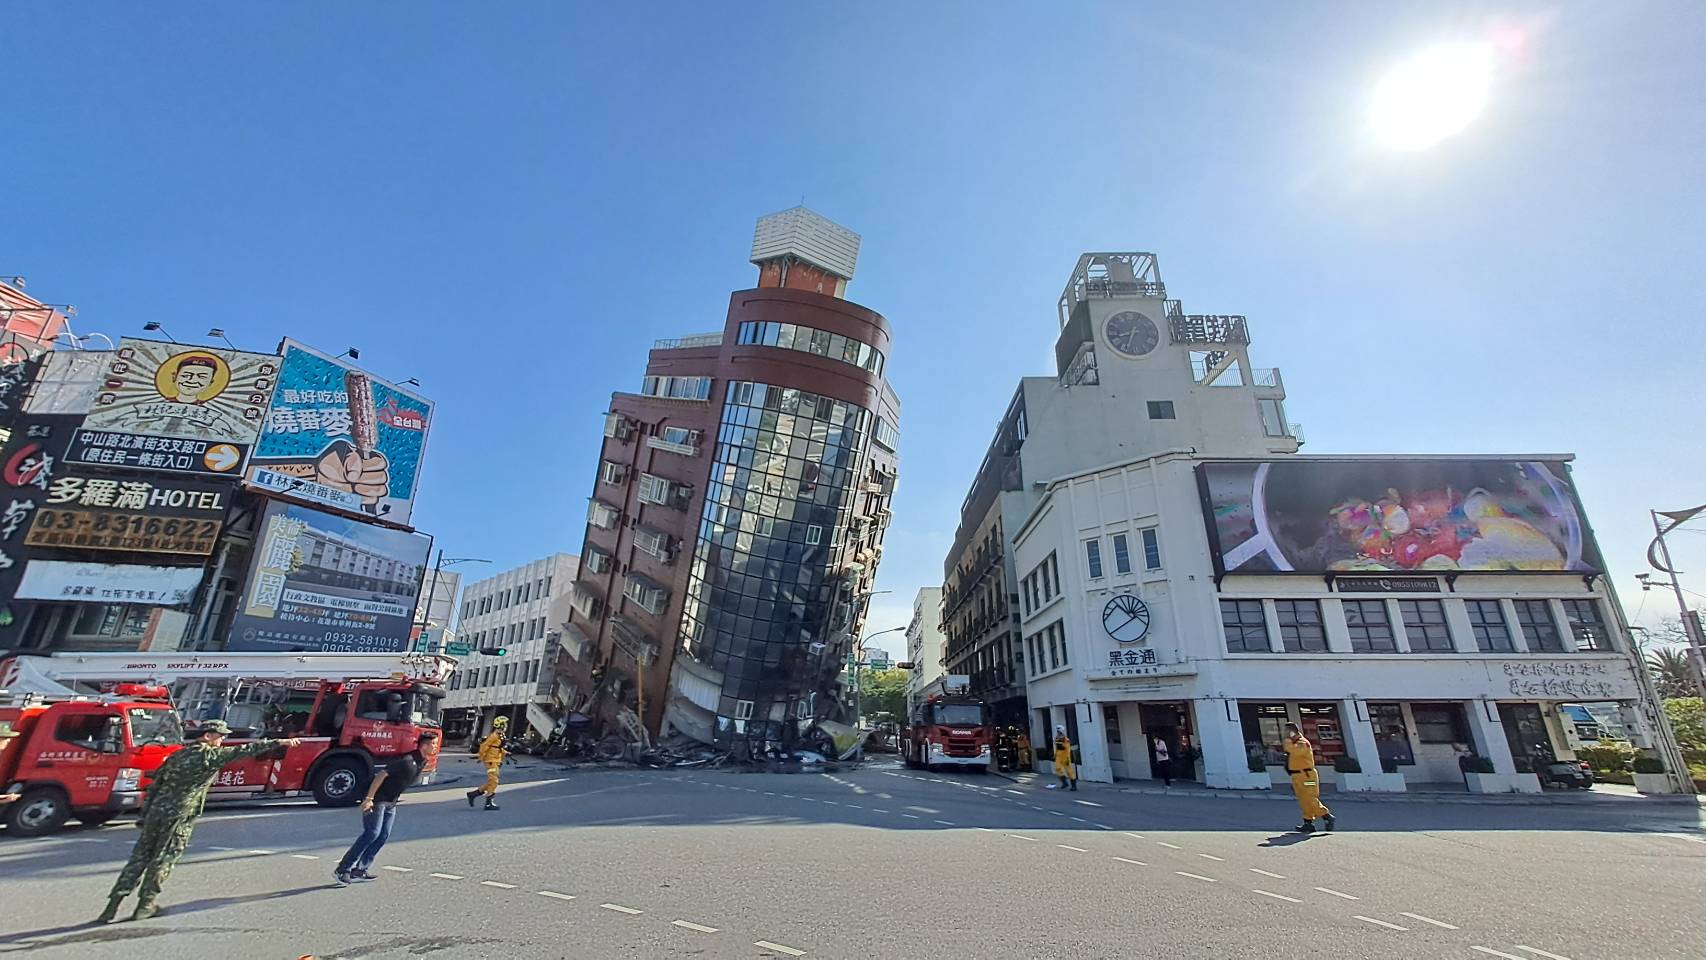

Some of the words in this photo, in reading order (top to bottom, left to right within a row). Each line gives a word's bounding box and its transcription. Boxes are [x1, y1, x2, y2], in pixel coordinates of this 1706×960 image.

[284, 389, 349, 404] 最好吃的
[264, 406, 353, 437] 燒番麥
[80, 431, 207, 455] 中山路北濱街交叉路口
[80, 447, 194, 470] (原住民一條街入口)
[46, 476, 152, 510] 多羅滿
[149, 489, 224, 510] HOTEL
[37, 511, 215, 538] 03-8316622
[324, 631, 400, 648] 0932-581018
[1109, 648, 1157, 667] 黑金通
